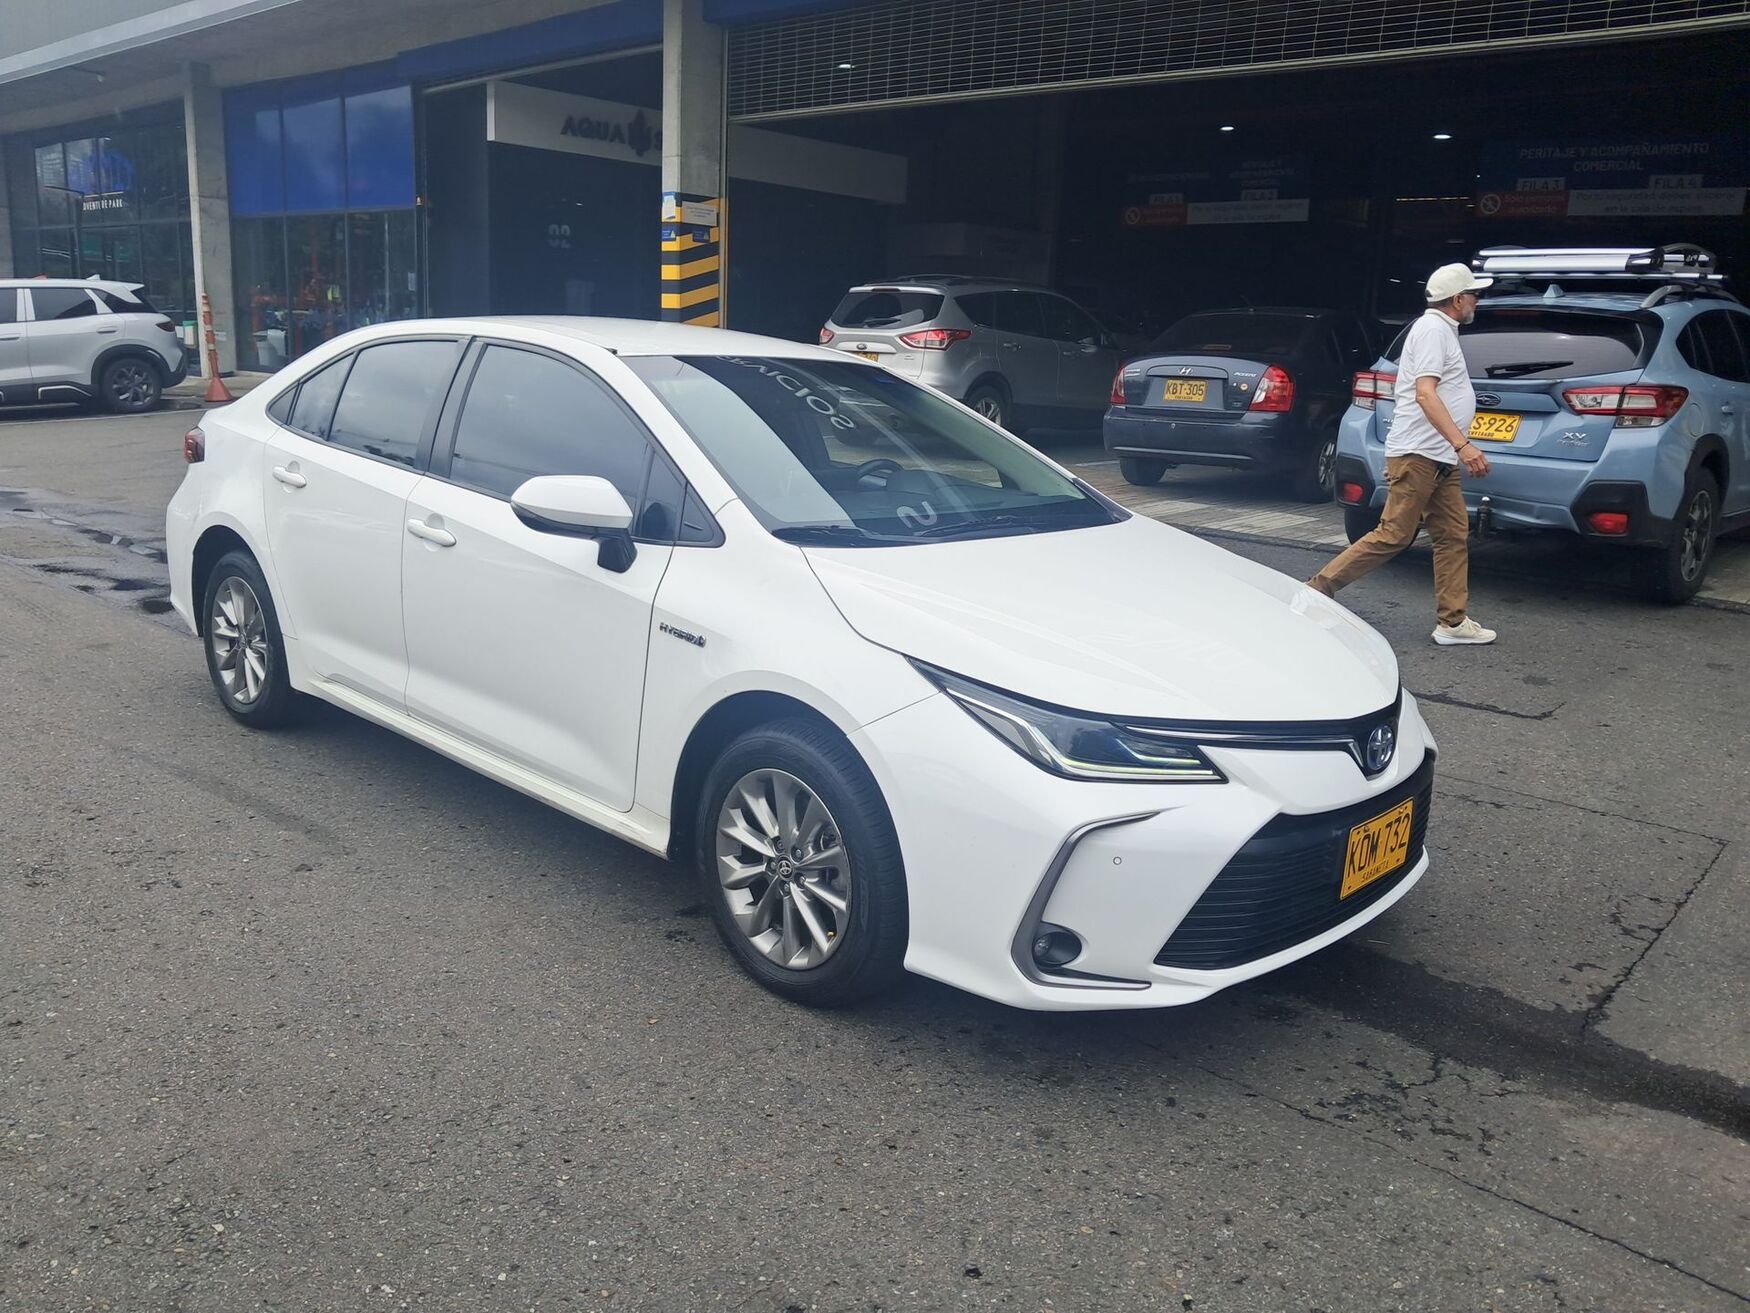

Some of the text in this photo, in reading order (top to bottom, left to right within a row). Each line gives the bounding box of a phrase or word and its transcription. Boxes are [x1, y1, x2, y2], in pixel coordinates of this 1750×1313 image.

[560, 114, 625, 144] AQUA
[1519, 146, 1576, 160] PERITAJE
[1573, 160, 1644, 172] COMERCIAL
[1522, 180, 1549, 190] FILA
[1654, 177, 1684, 189] FILA
[1562, 431, 1587, 440] XV
[1384, 812, 1411, 858] 732
